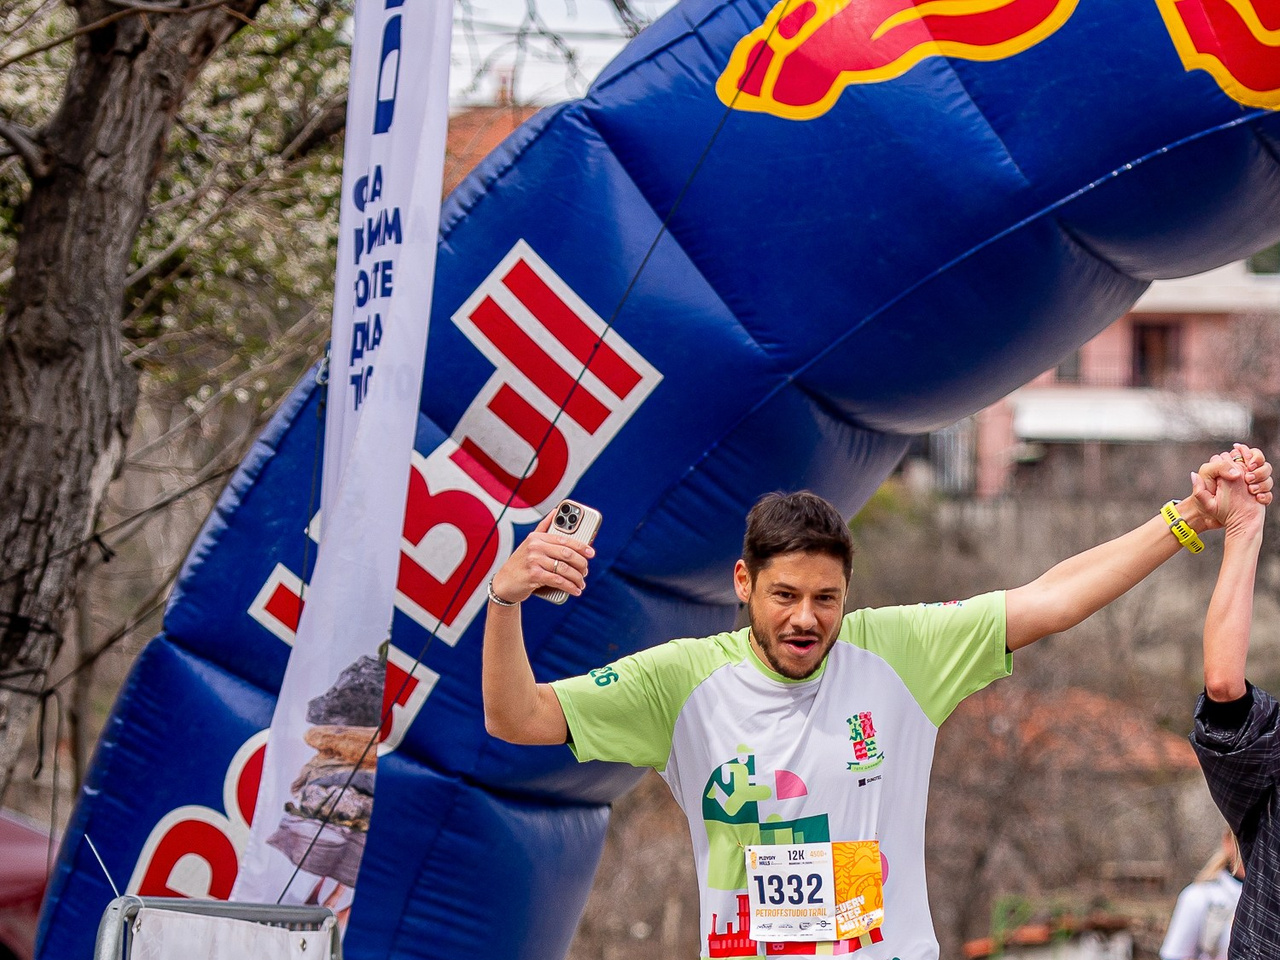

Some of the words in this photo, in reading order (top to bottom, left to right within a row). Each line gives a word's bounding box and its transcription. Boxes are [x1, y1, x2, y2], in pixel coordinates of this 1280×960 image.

[395, 252, 655, 638] Bull
[787, 849, 805, 861] 12K
[753, 873, 824, 905] 1332
